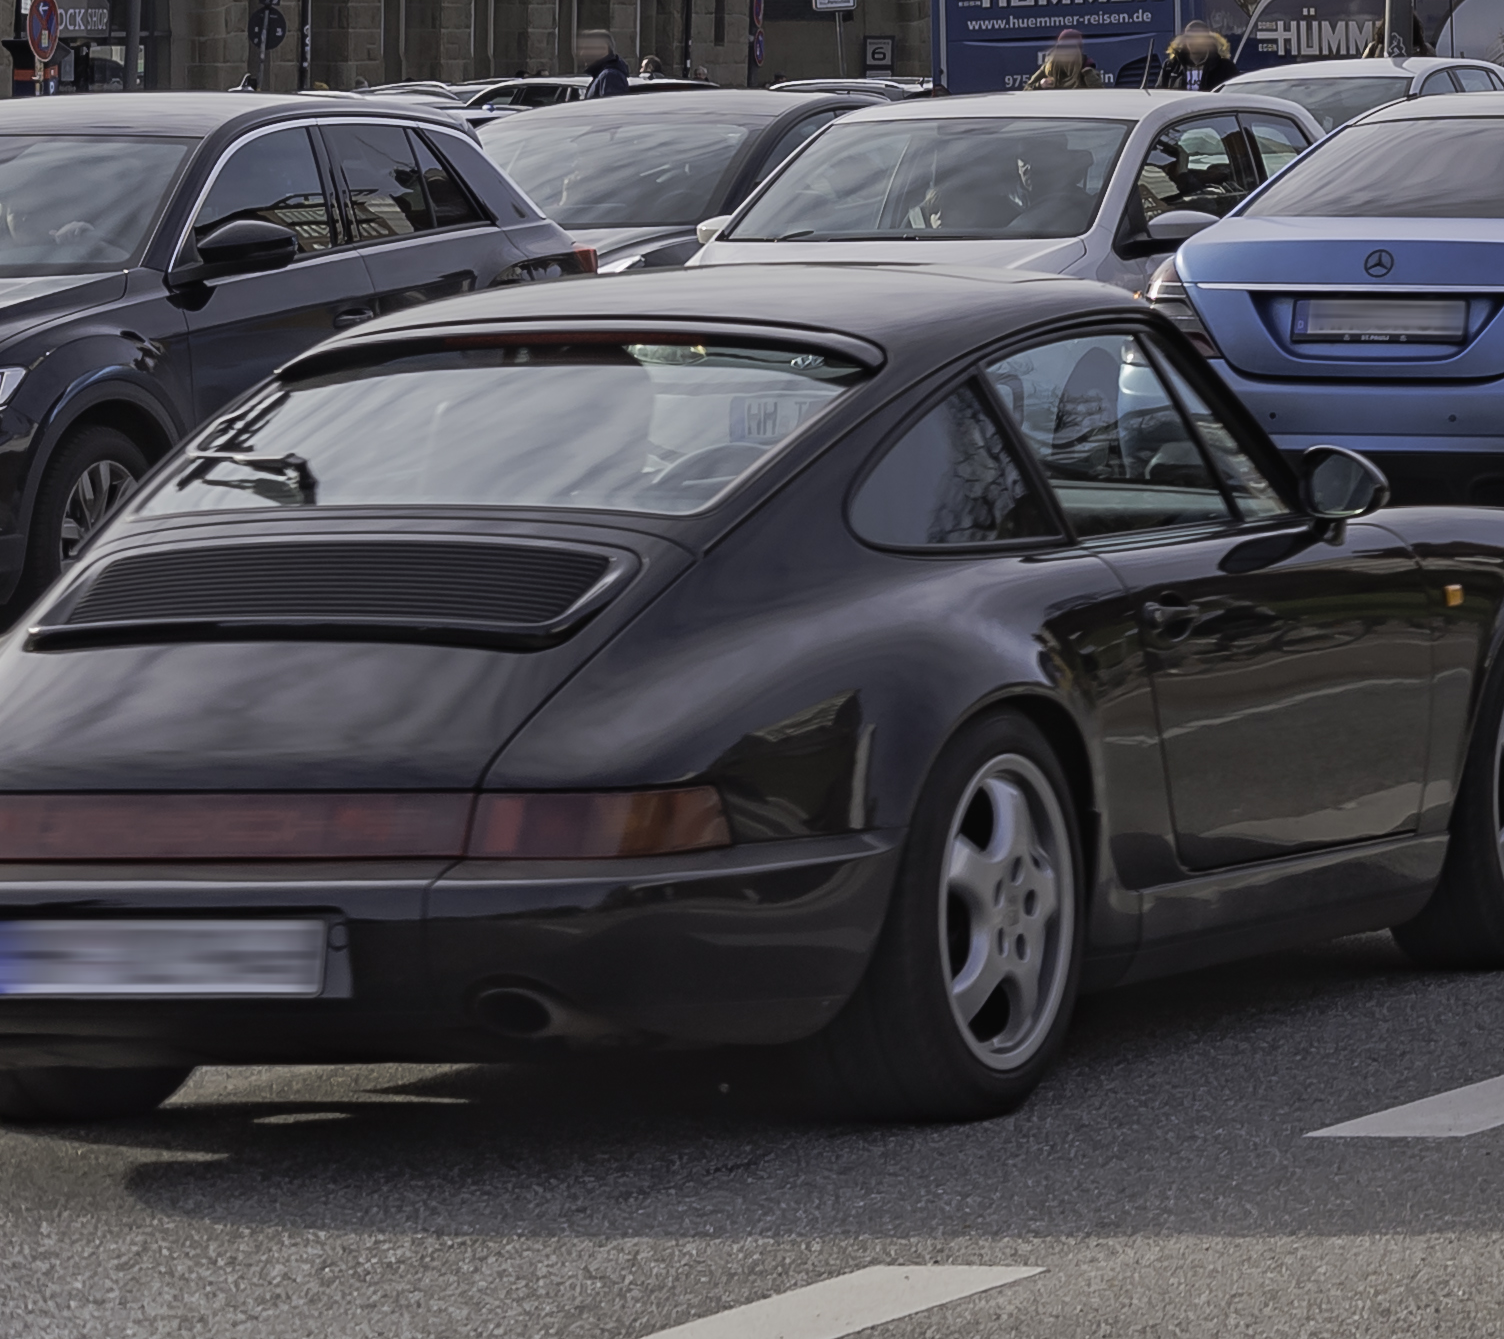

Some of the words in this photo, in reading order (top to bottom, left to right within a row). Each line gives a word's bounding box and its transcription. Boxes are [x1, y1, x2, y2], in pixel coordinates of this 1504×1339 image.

[58, 9, 85, 30] OCK
[87, 8, 109, 30] SHOP
[967, 10, 1152, 30] www.huemmer-reisen.de
[871, 47, 887, 62] 6
